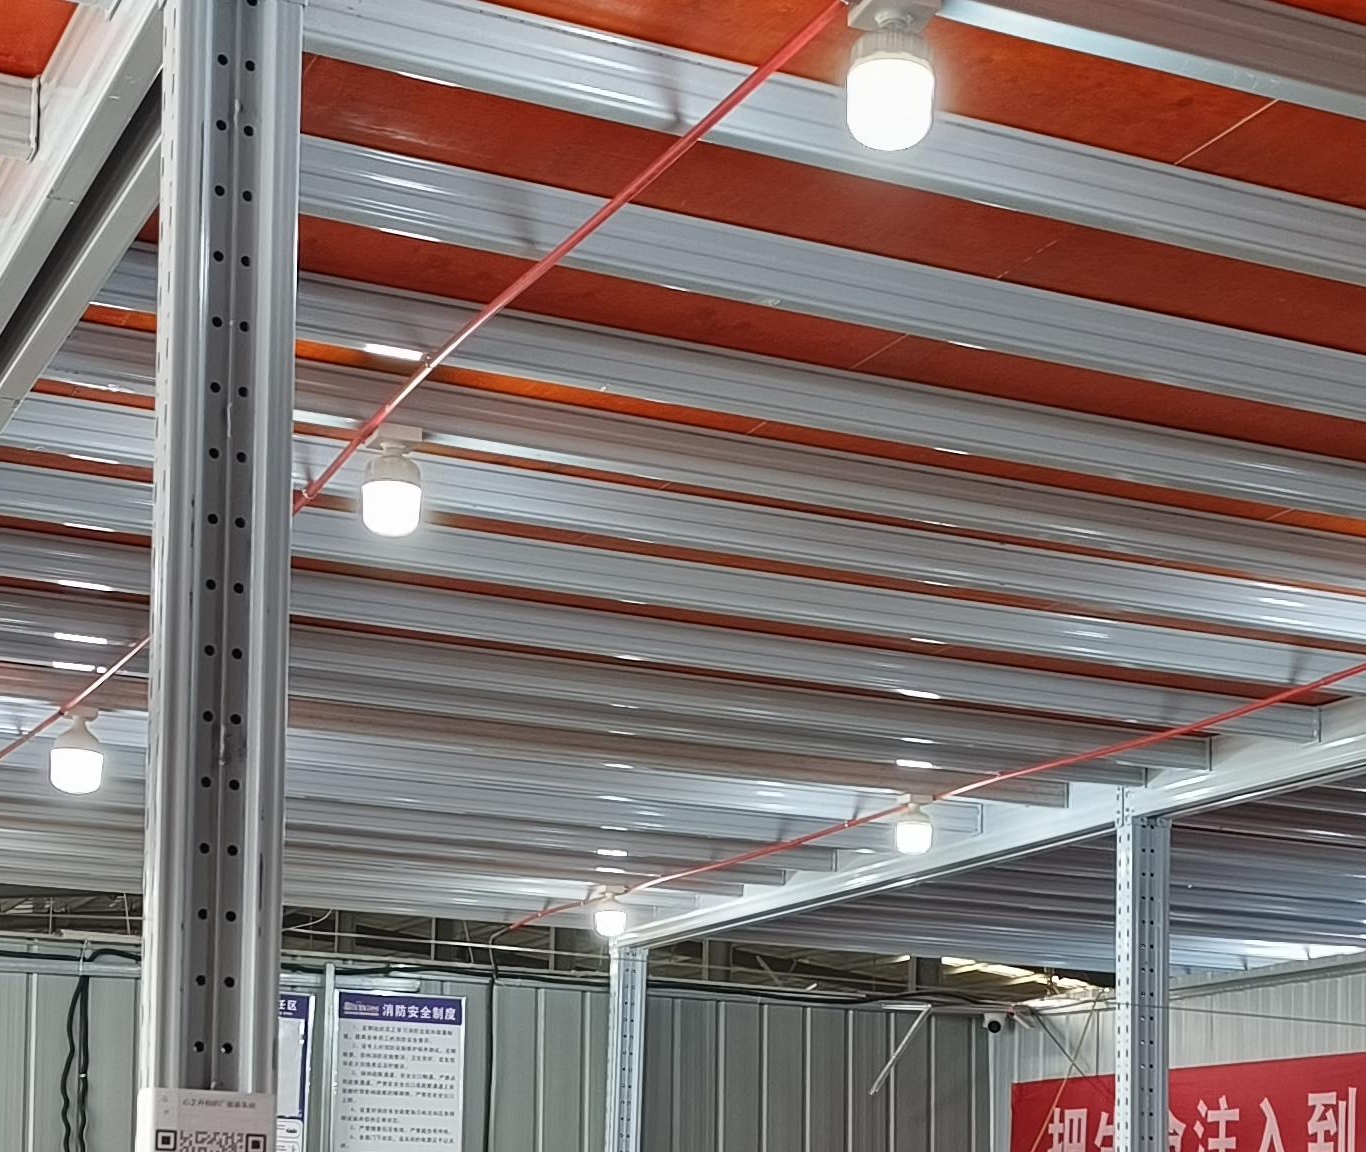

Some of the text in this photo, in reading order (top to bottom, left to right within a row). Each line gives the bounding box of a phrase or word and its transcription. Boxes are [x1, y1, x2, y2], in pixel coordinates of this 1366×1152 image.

[382, 1004, 456, 1020] 消防安全制度
